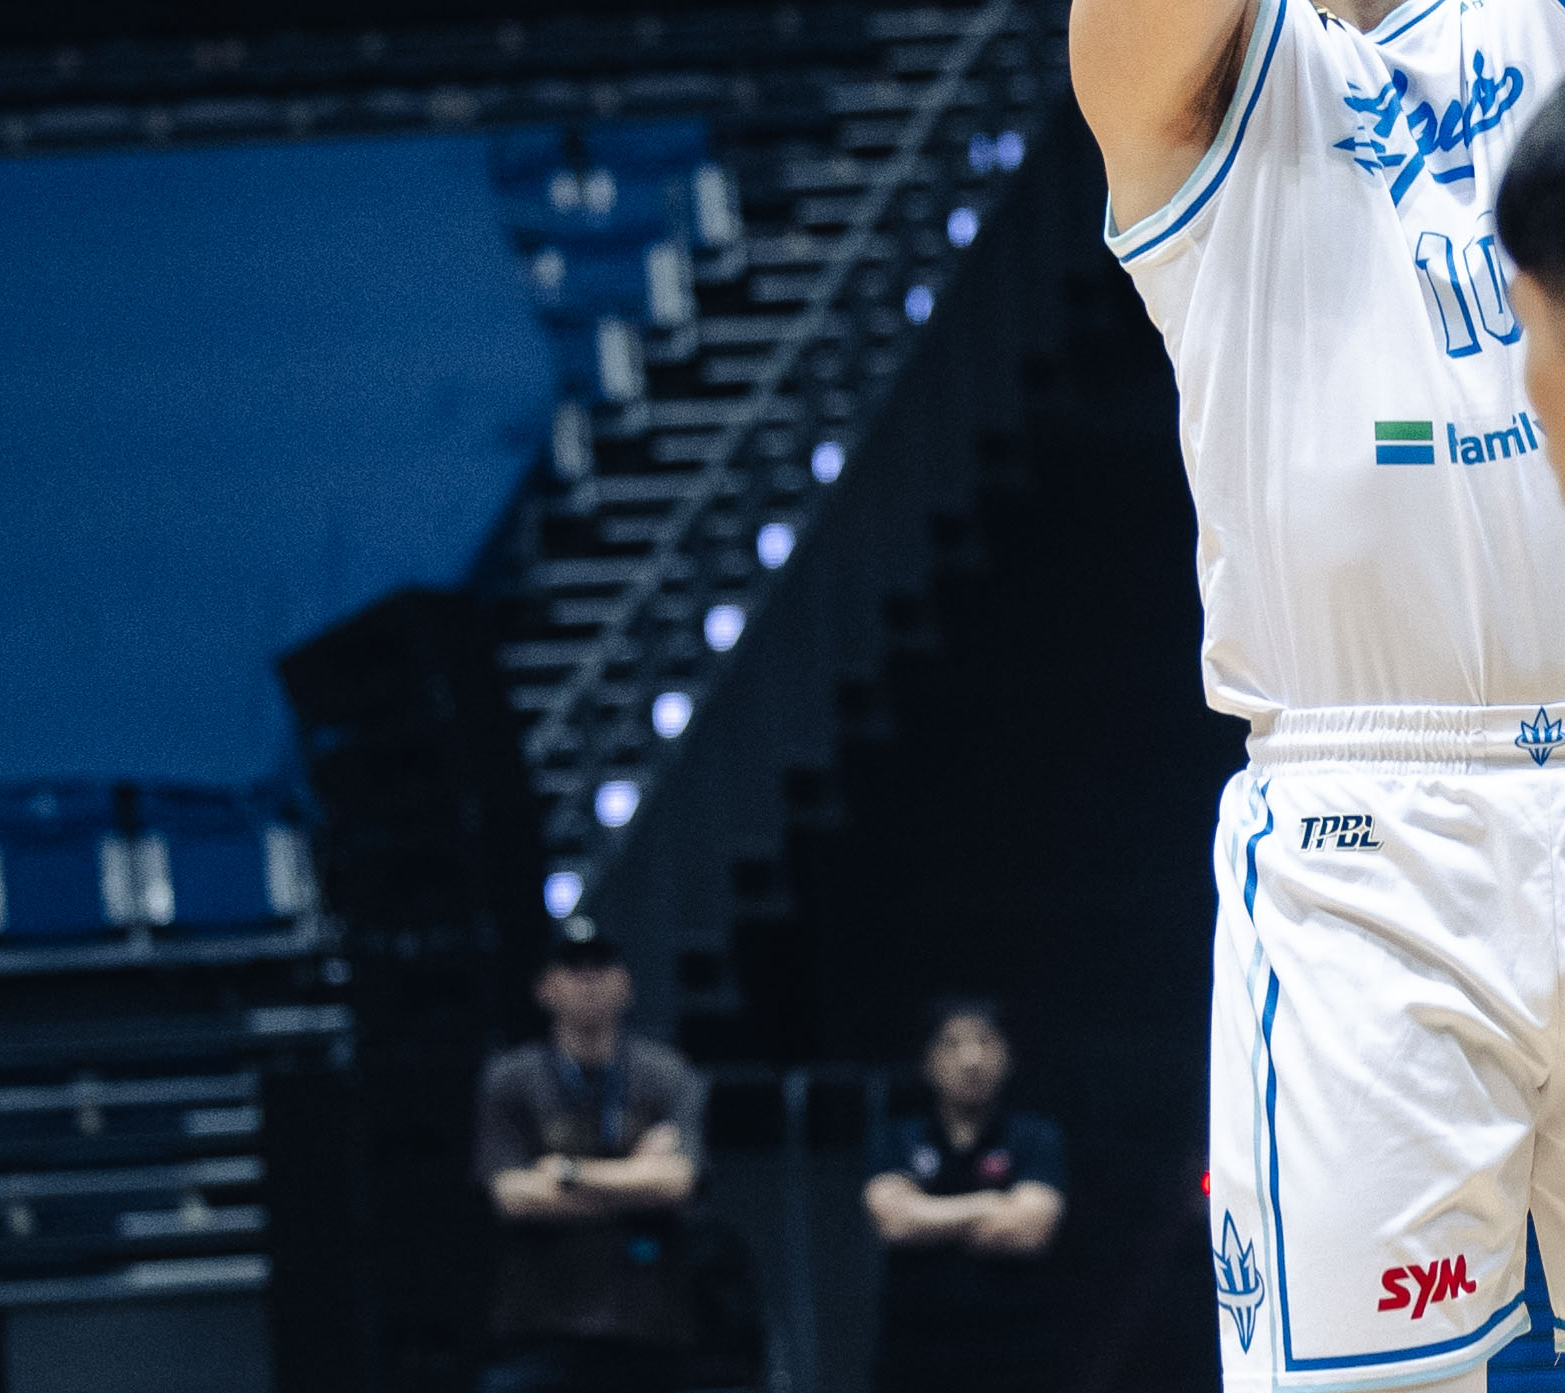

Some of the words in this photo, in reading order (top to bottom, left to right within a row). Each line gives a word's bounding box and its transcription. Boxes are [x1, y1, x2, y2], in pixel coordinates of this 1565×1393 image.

[1446, 411, 1546, 466] amil
[1298, 813, 1383, 851] TPBL
[1377, 1254, 1478, 1320] SYM
